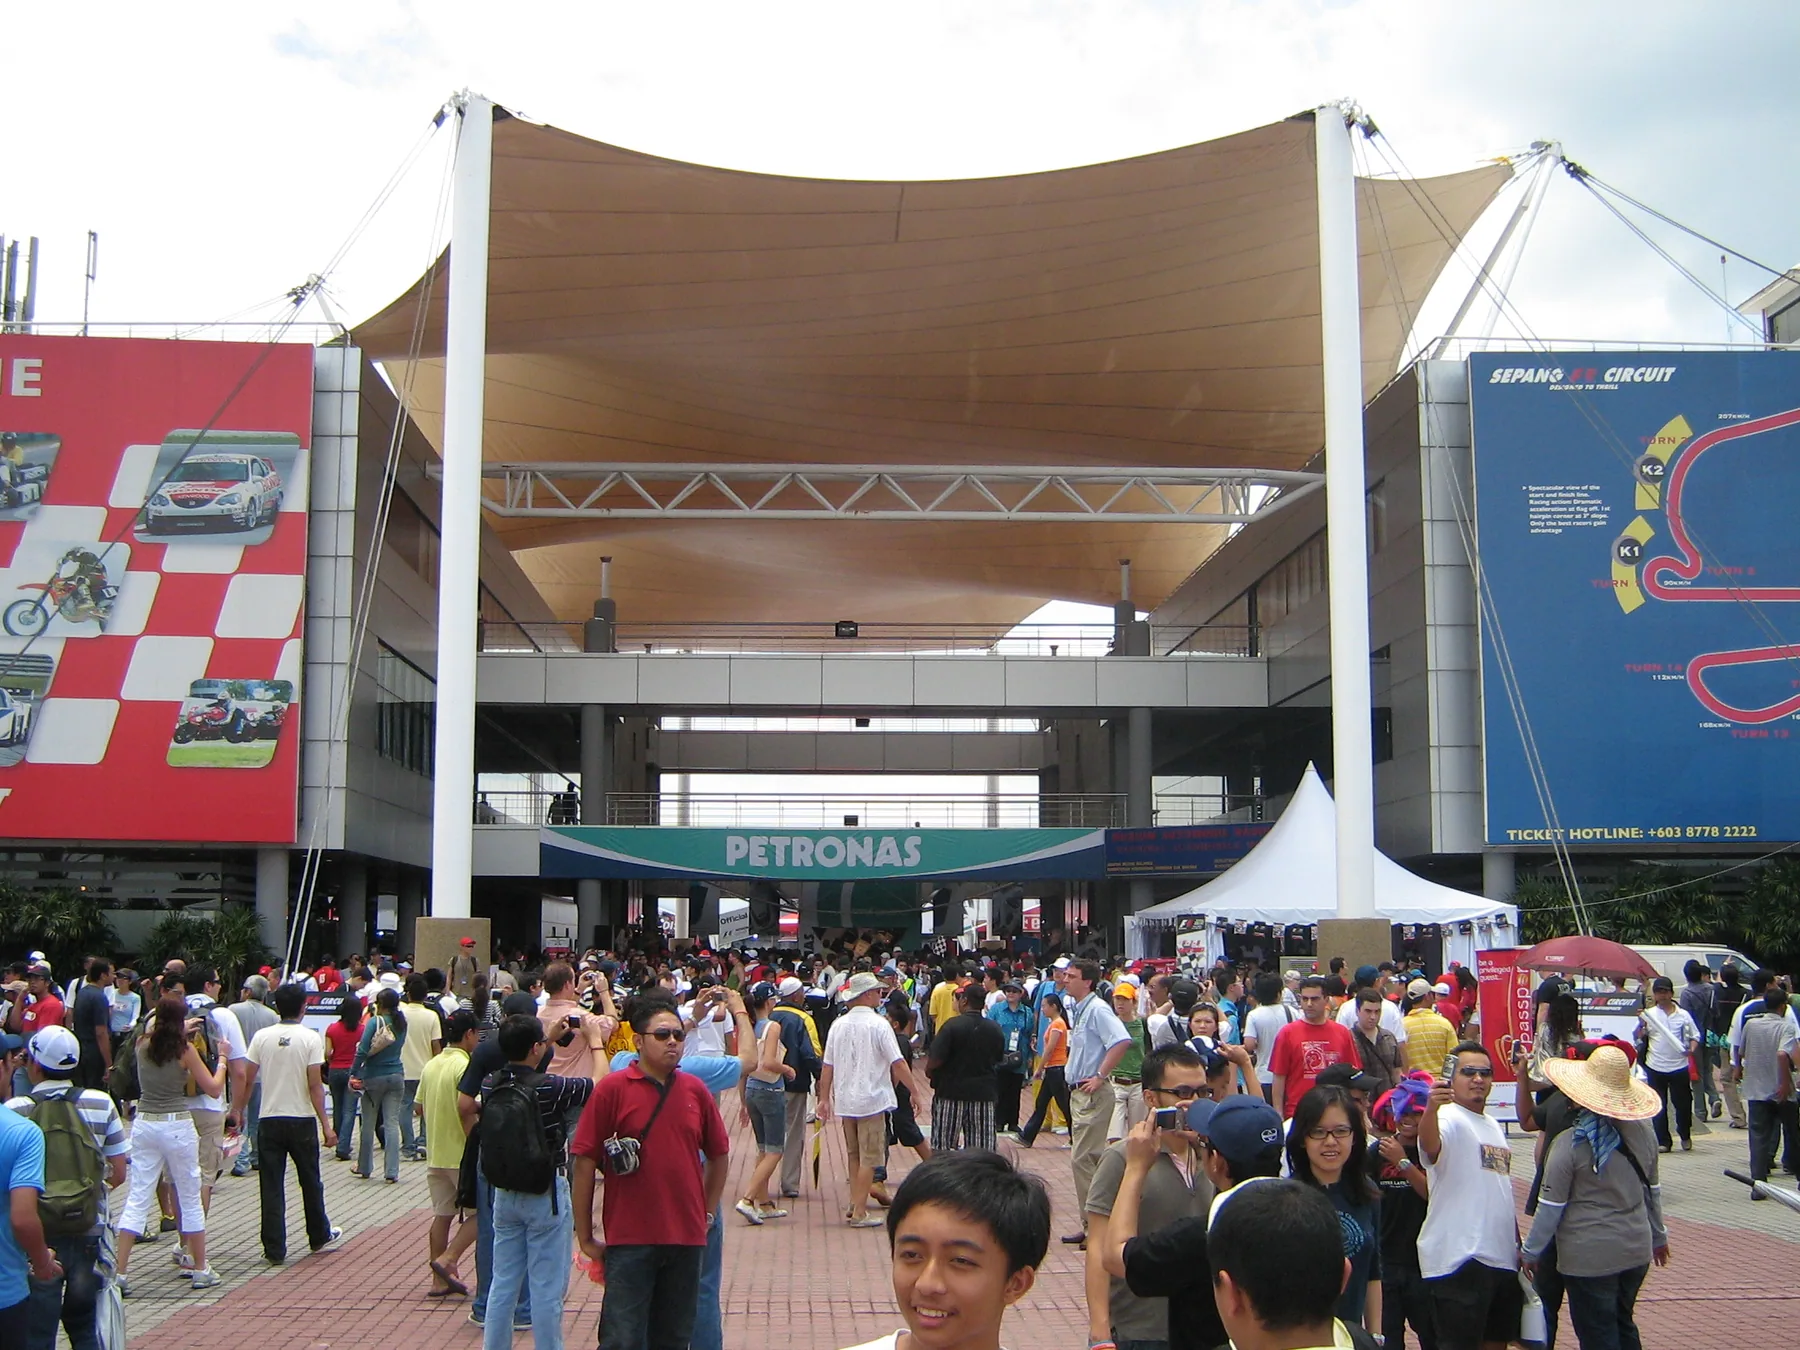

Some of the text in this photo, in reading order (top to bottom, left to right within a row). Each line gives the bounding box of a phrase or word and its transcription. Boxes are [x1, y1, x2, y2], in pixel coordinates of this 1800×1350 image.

[0, 358, 43, 397] E
[1489, 367, 1564, 384] SEPANG
[1603, 366, 1677, 383] CIRCUIT
[1642, 465, 1664, 476] K2
[1619, 546, 1640, 557] K1
[1591, 579, 1629, 588] TURN
[1506, 825, 1757, 841] TICKET HOTLINE: +603 8778 2222
[726, 835, 922, 868] PETRONAS
[720, 912, 748, 926] Official
[1479, 966, 1511, 974] privileged
[320, 997, 345, 1005] CIRCU
[1606, 998, 1637, 1006] CIRCUIT
